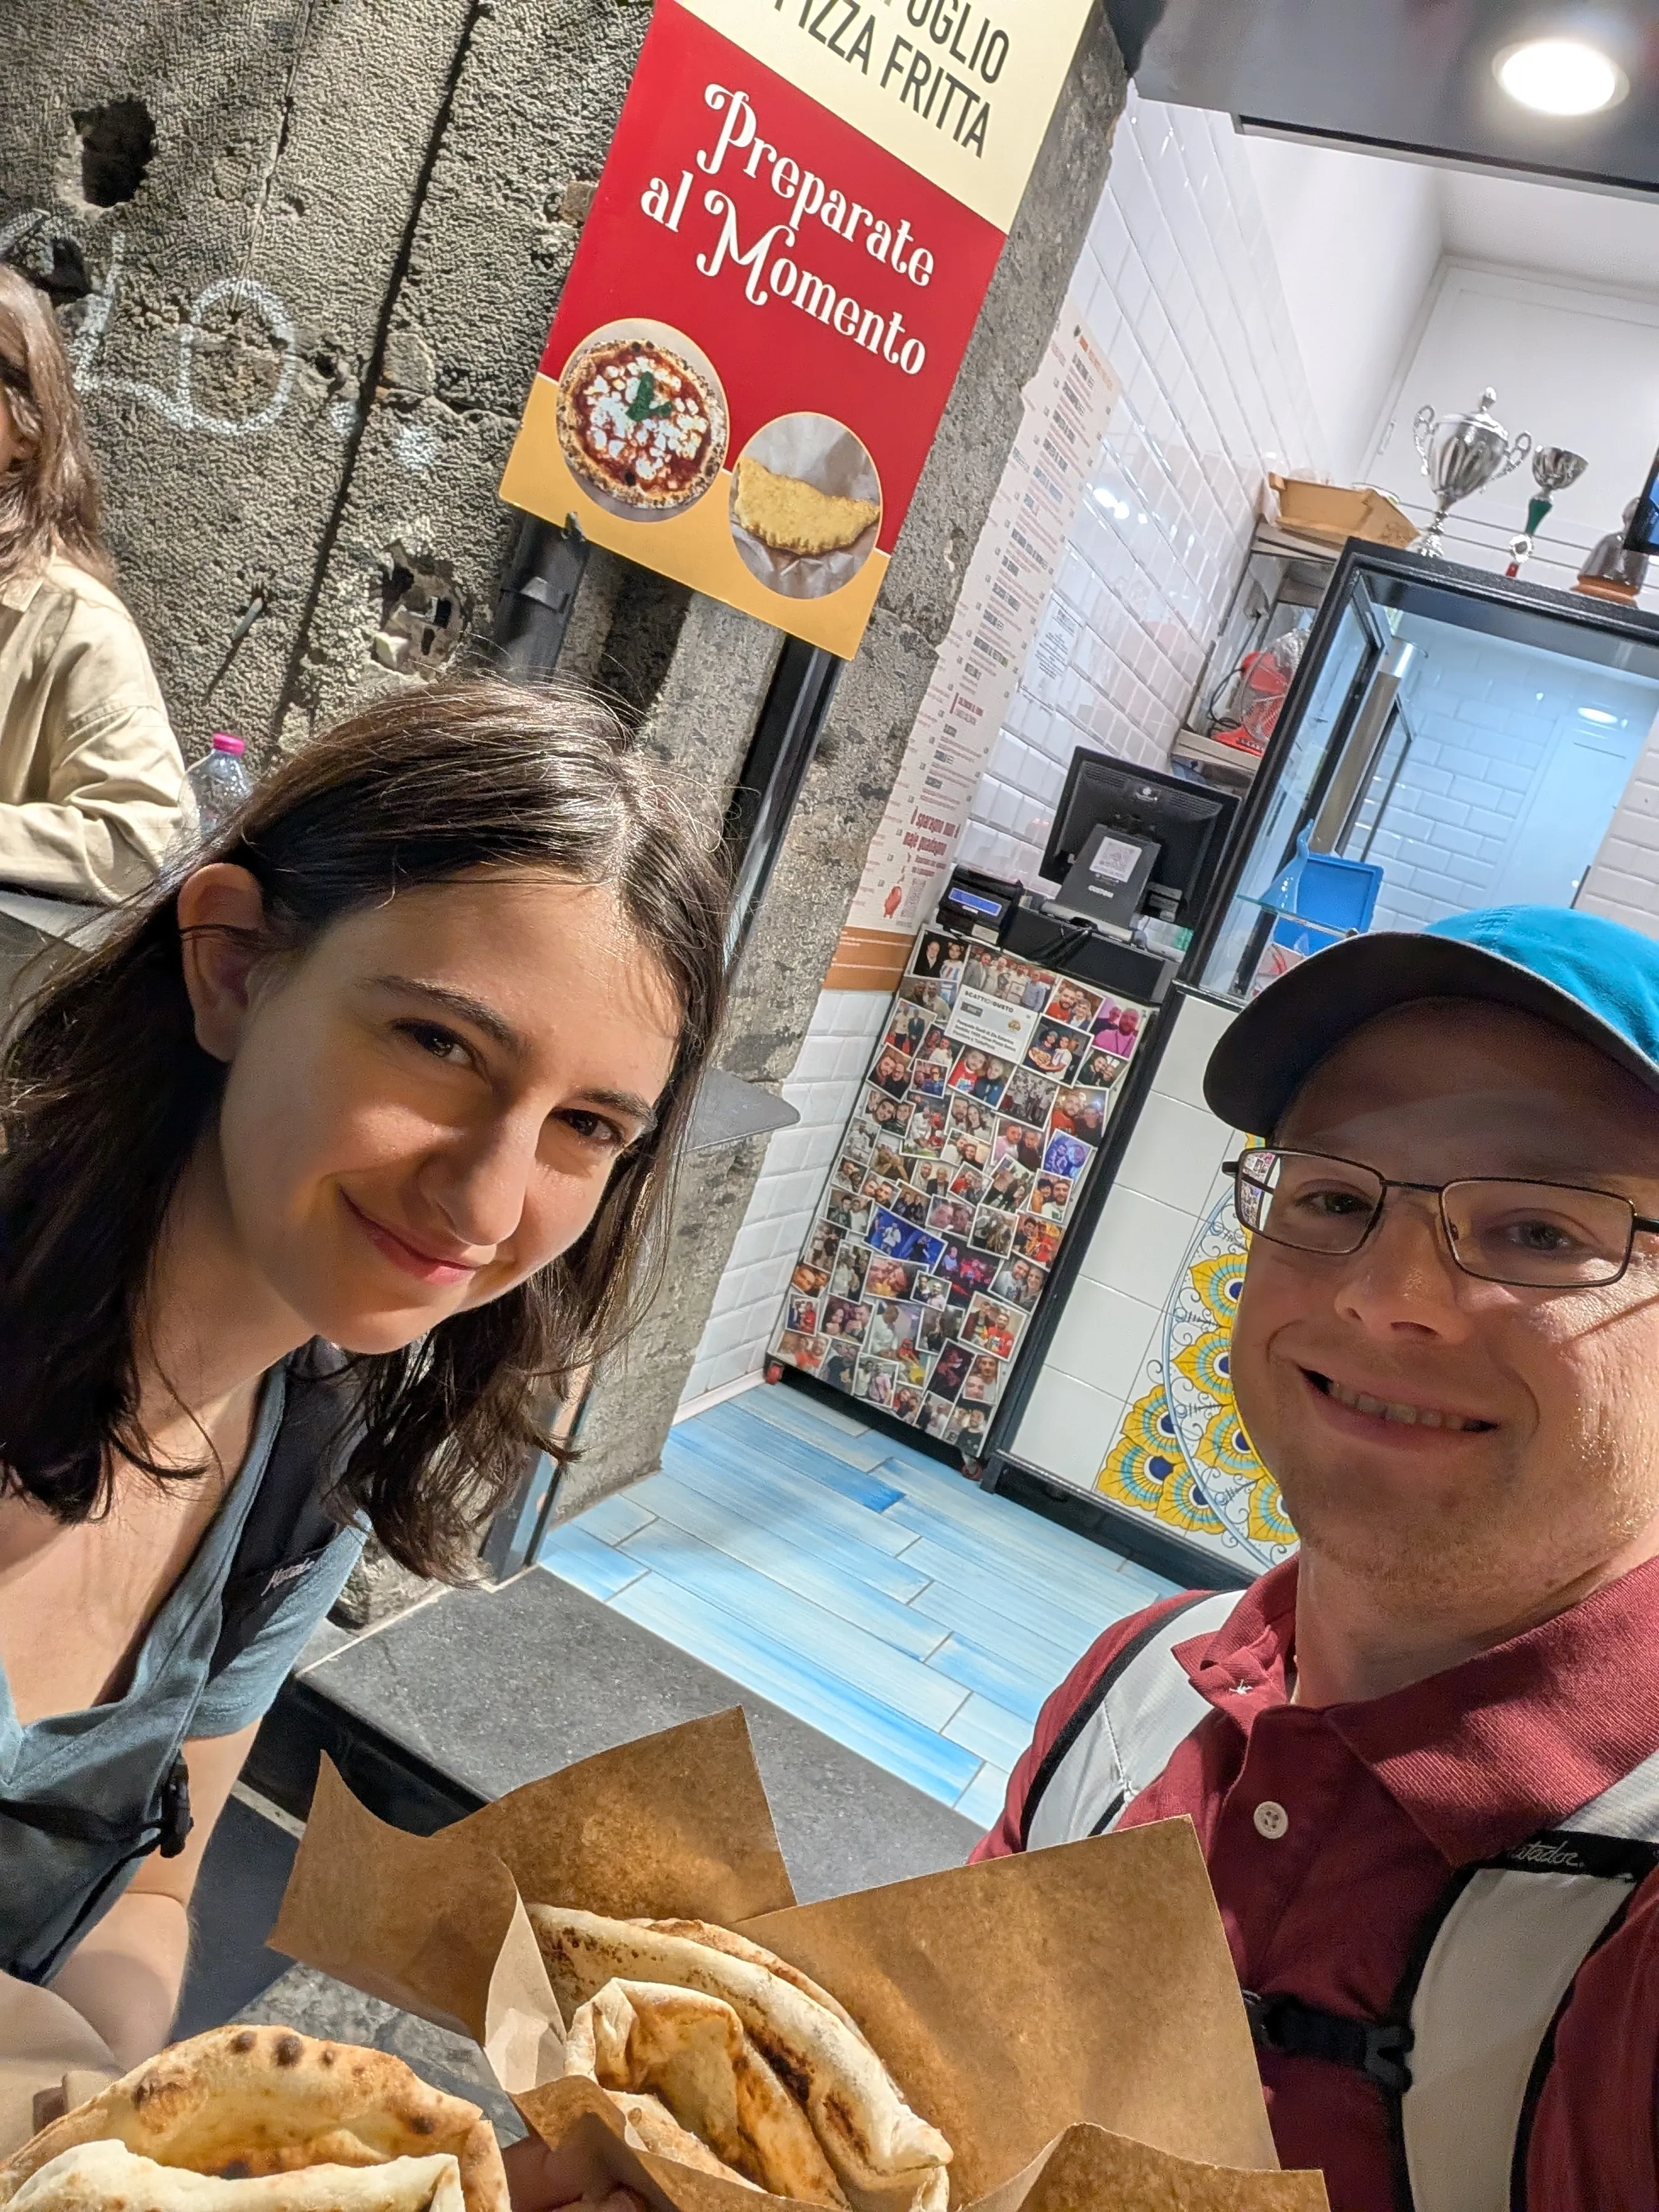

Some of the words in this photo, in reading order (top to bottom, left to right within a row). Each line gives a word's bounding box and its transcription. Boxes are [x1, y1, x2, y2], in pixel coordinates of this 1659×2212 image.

[774, 0, 876, 76] IZZA
[880, 35, 991, 159] FRITTA
[640, 170, 694, 232] al
[695, 189, 926, 375] Momento
[696, 83, 934, 287] Preparate
